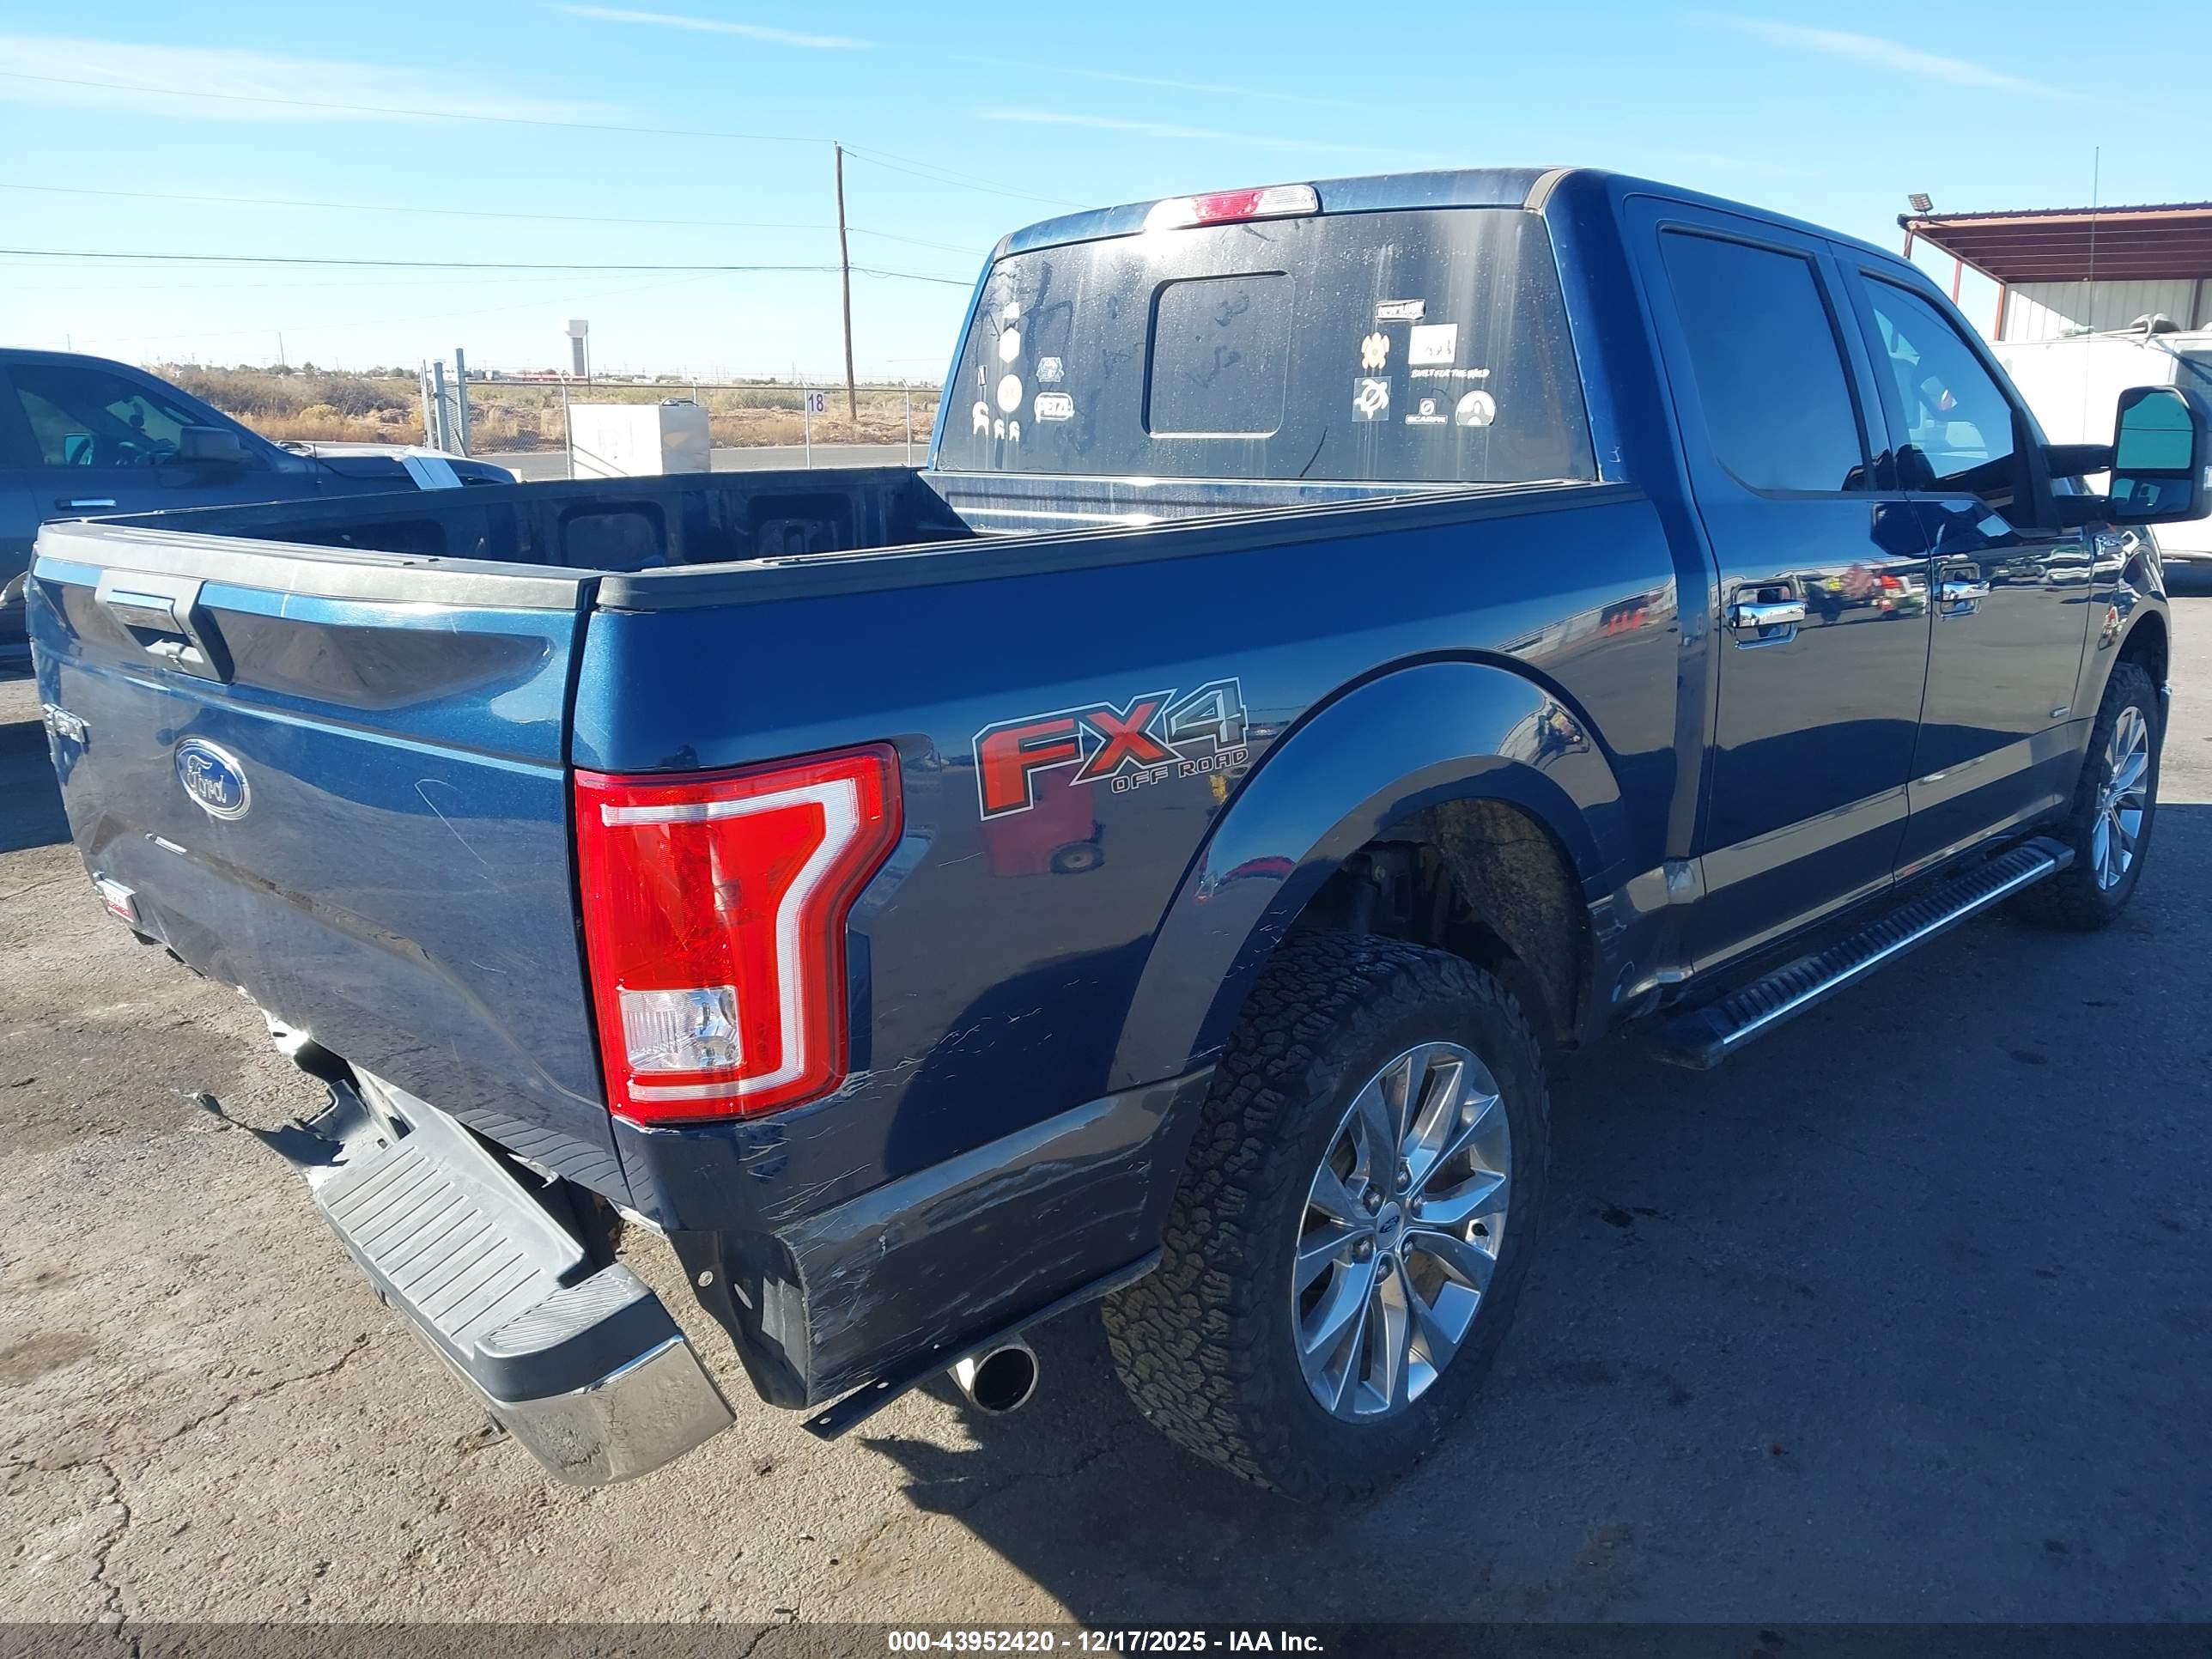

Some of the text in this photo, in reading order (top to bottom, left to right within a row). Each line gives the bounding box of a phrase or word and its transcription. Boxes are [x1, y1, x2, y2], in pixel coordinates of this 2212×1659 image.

[808, 393, 824, 412] 18
[971, 677, 1249, 822] FX4
[1110, 748, 1250, 794] OFF ROAD
[186, 754, 228, 804] Ford
